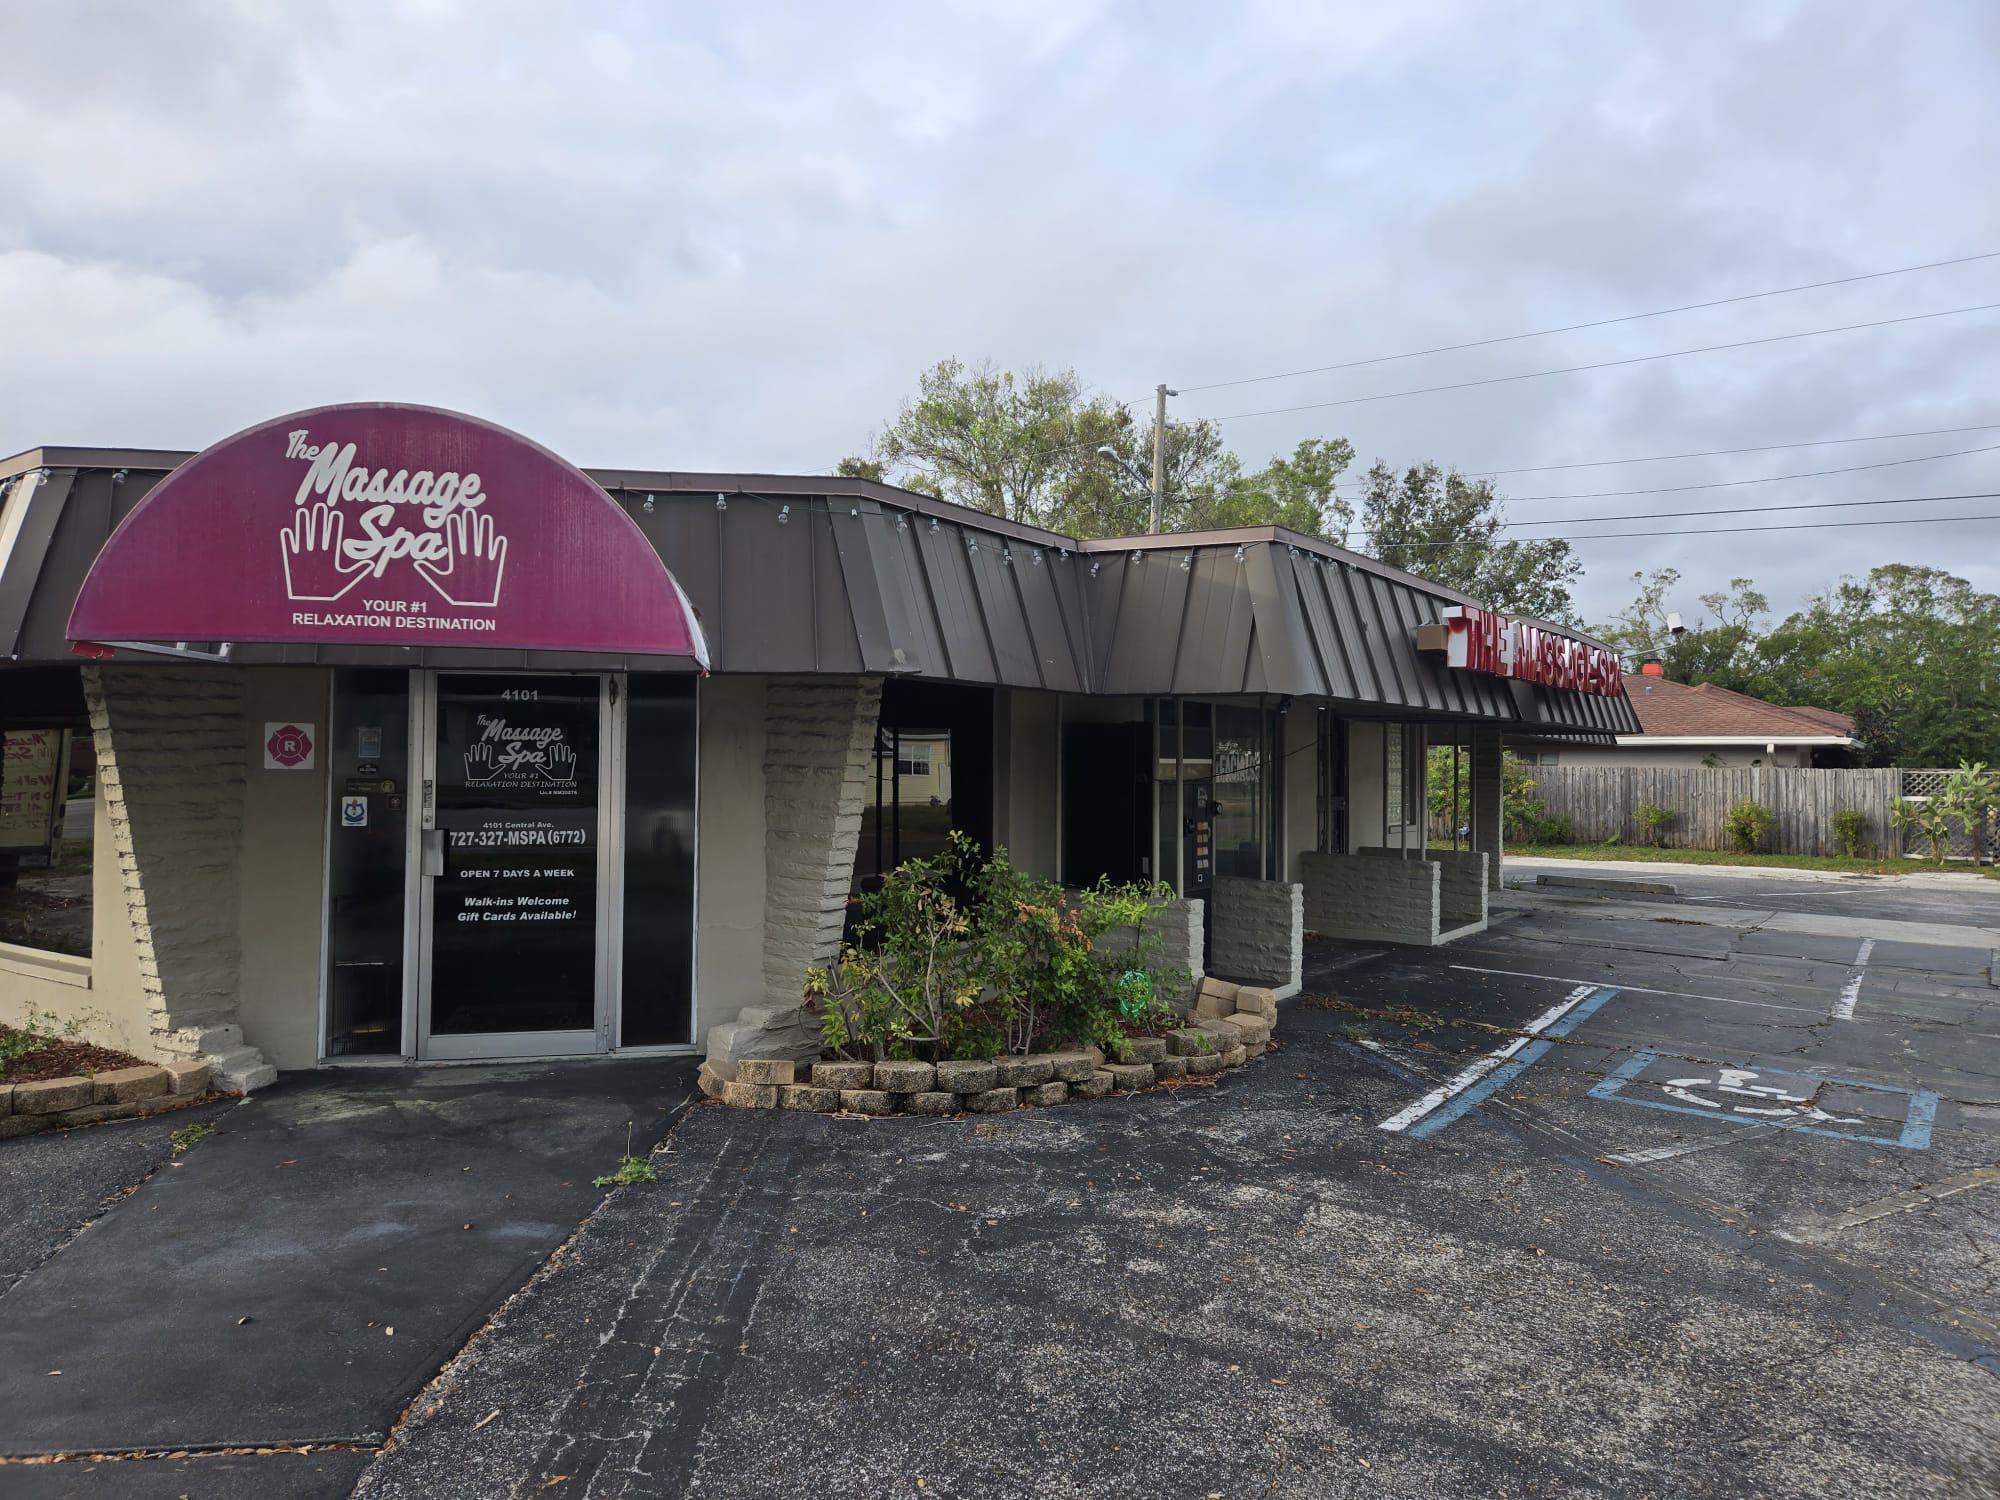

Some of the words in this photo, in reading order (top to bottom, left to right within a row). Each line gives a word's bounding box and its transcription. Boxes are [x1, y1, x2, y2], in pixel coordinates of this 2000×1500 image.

[285, 430, 319, 460] The
[295, 442, 486, 528] Massage
[343, 505, 448, 578] Spa
[363, 600, 407, 613] YOUR
[410, 602, 427, 613] #1
[292, 613, 391, 628] RELAXATION
[395, 616, 496, 631] DESTINATION
[1455, 605, 1509, 678] THE
[1513, 621, 1597, 694] MASSAGE
[502, 689, 538, 701] 4101
[477, 714, 491, 726] The
[481, 718, 564, 749] Massage
[284, 740, 297, 752] R
[498, 742, 547, 770] Spa
[465, 780, 519, 788] RELAXATION
[520, 780, 577, 788] DESTINATION
[505, 821, 535, 829] Central
[460, 870, 490, 878] OPEN
[493, 870, 500, 878] 7
[503, 869, 530, 878] DAYS
[533, 869, 541, 877] A
[544, 869, 575, 877] WEEK
[464, 897, 514, 906] Walk-ins
[517, 896, 570, 905] Welcome
[457, 912, 480, 922] Gift
[483, 911, 516, 921] Cards
[519, 910, 577, 920] Available!
